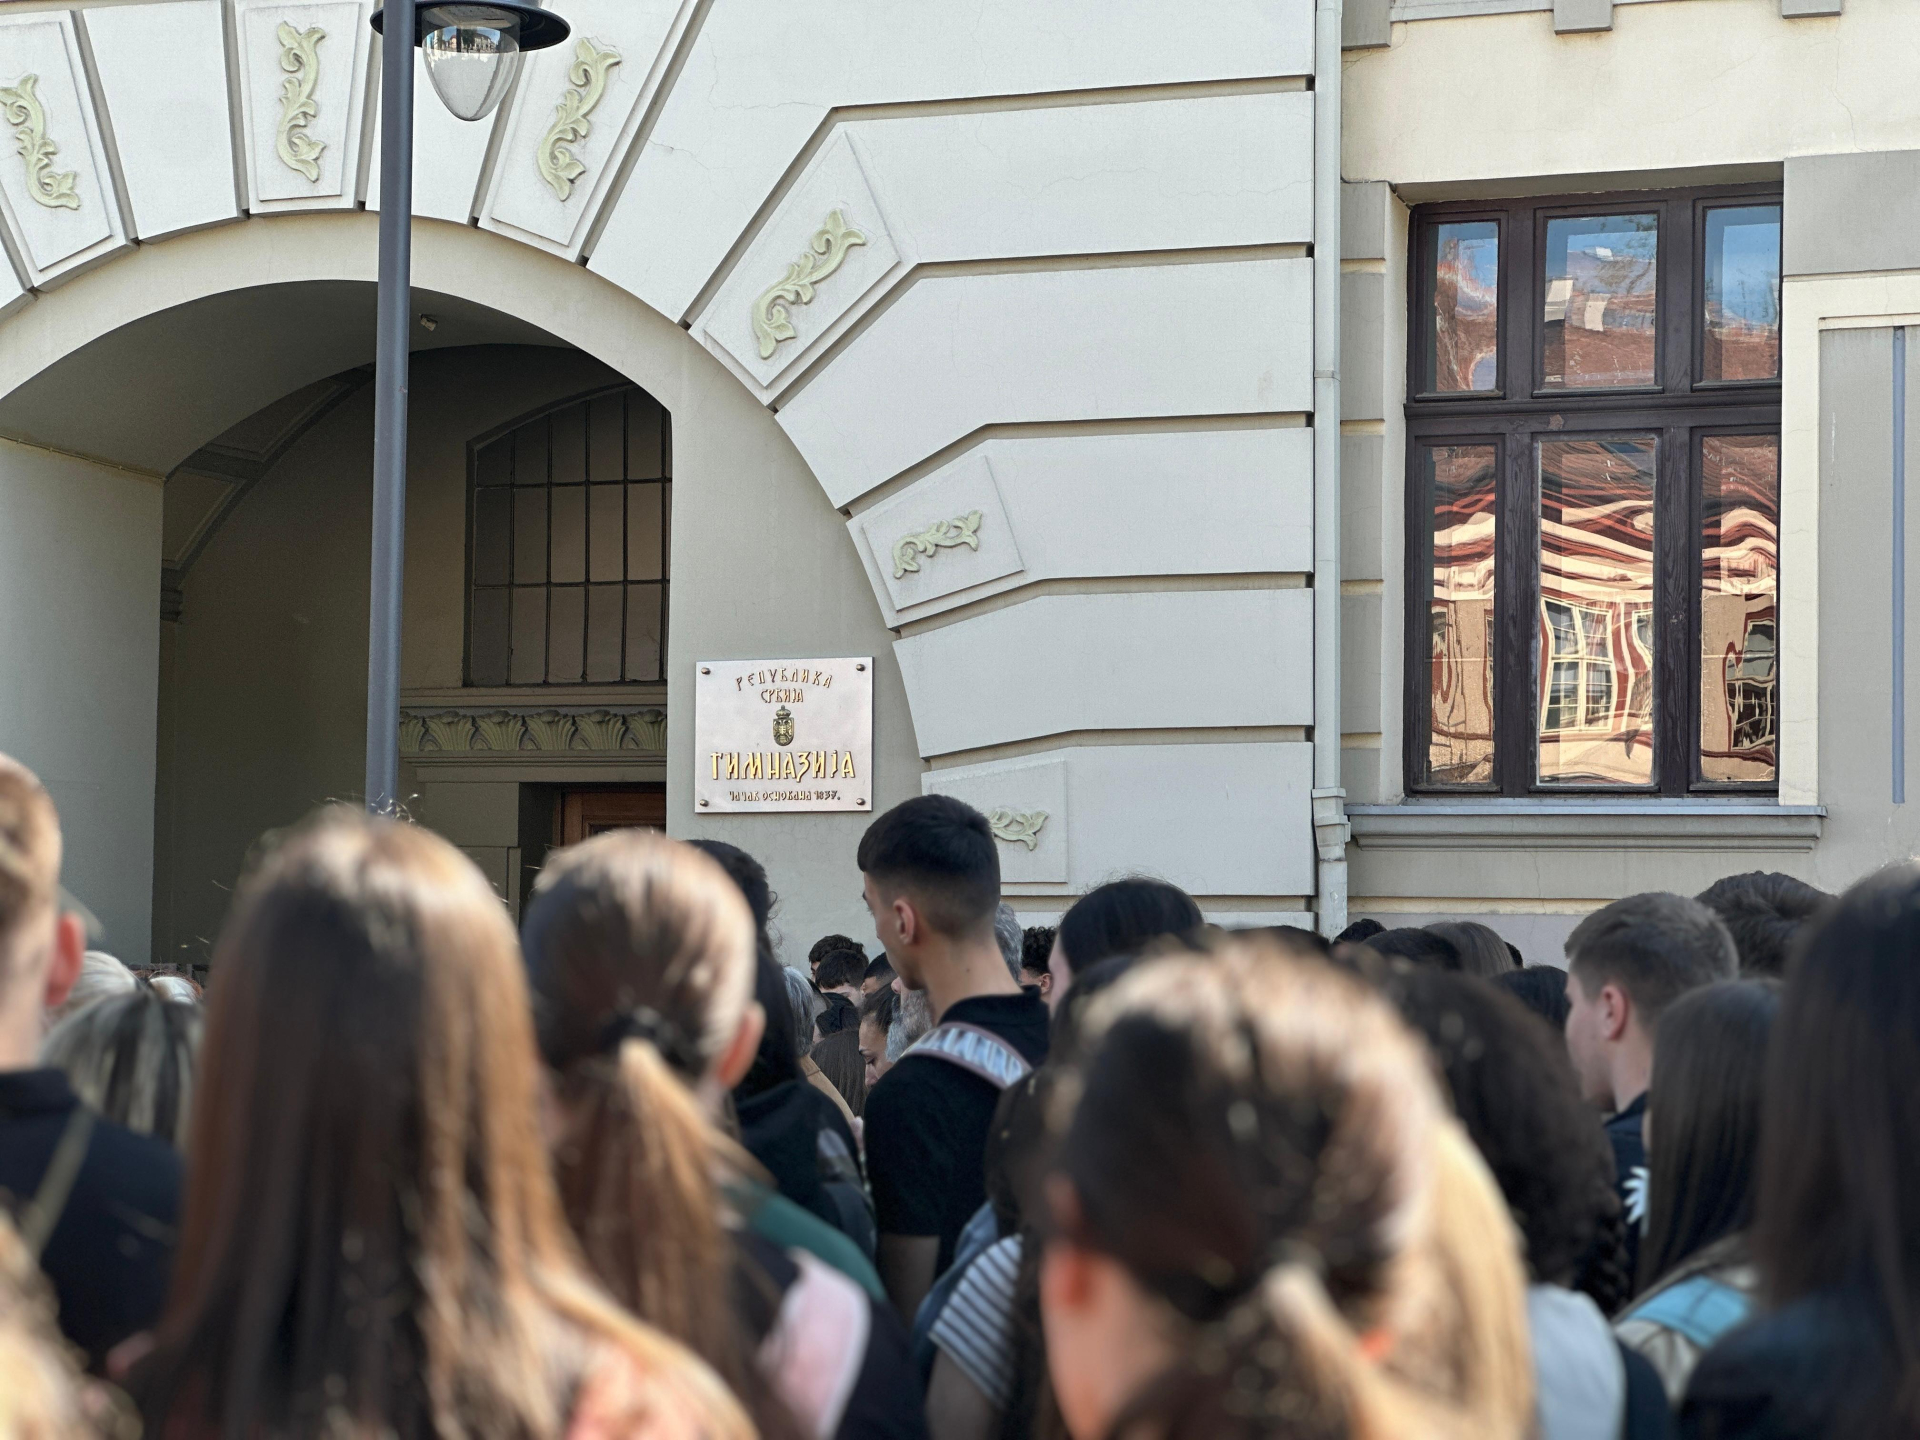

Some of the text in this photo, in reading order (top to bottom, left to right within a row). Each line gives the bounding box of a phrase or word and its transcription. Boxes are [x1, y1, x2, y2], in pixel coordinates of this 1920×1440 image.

[735, 668, 833, 691] РЕПУБЛИКА
[760, 688, 804, 703] СРБИЈА
[710, 750, 855, 783] ГИМНАЗИЈА
